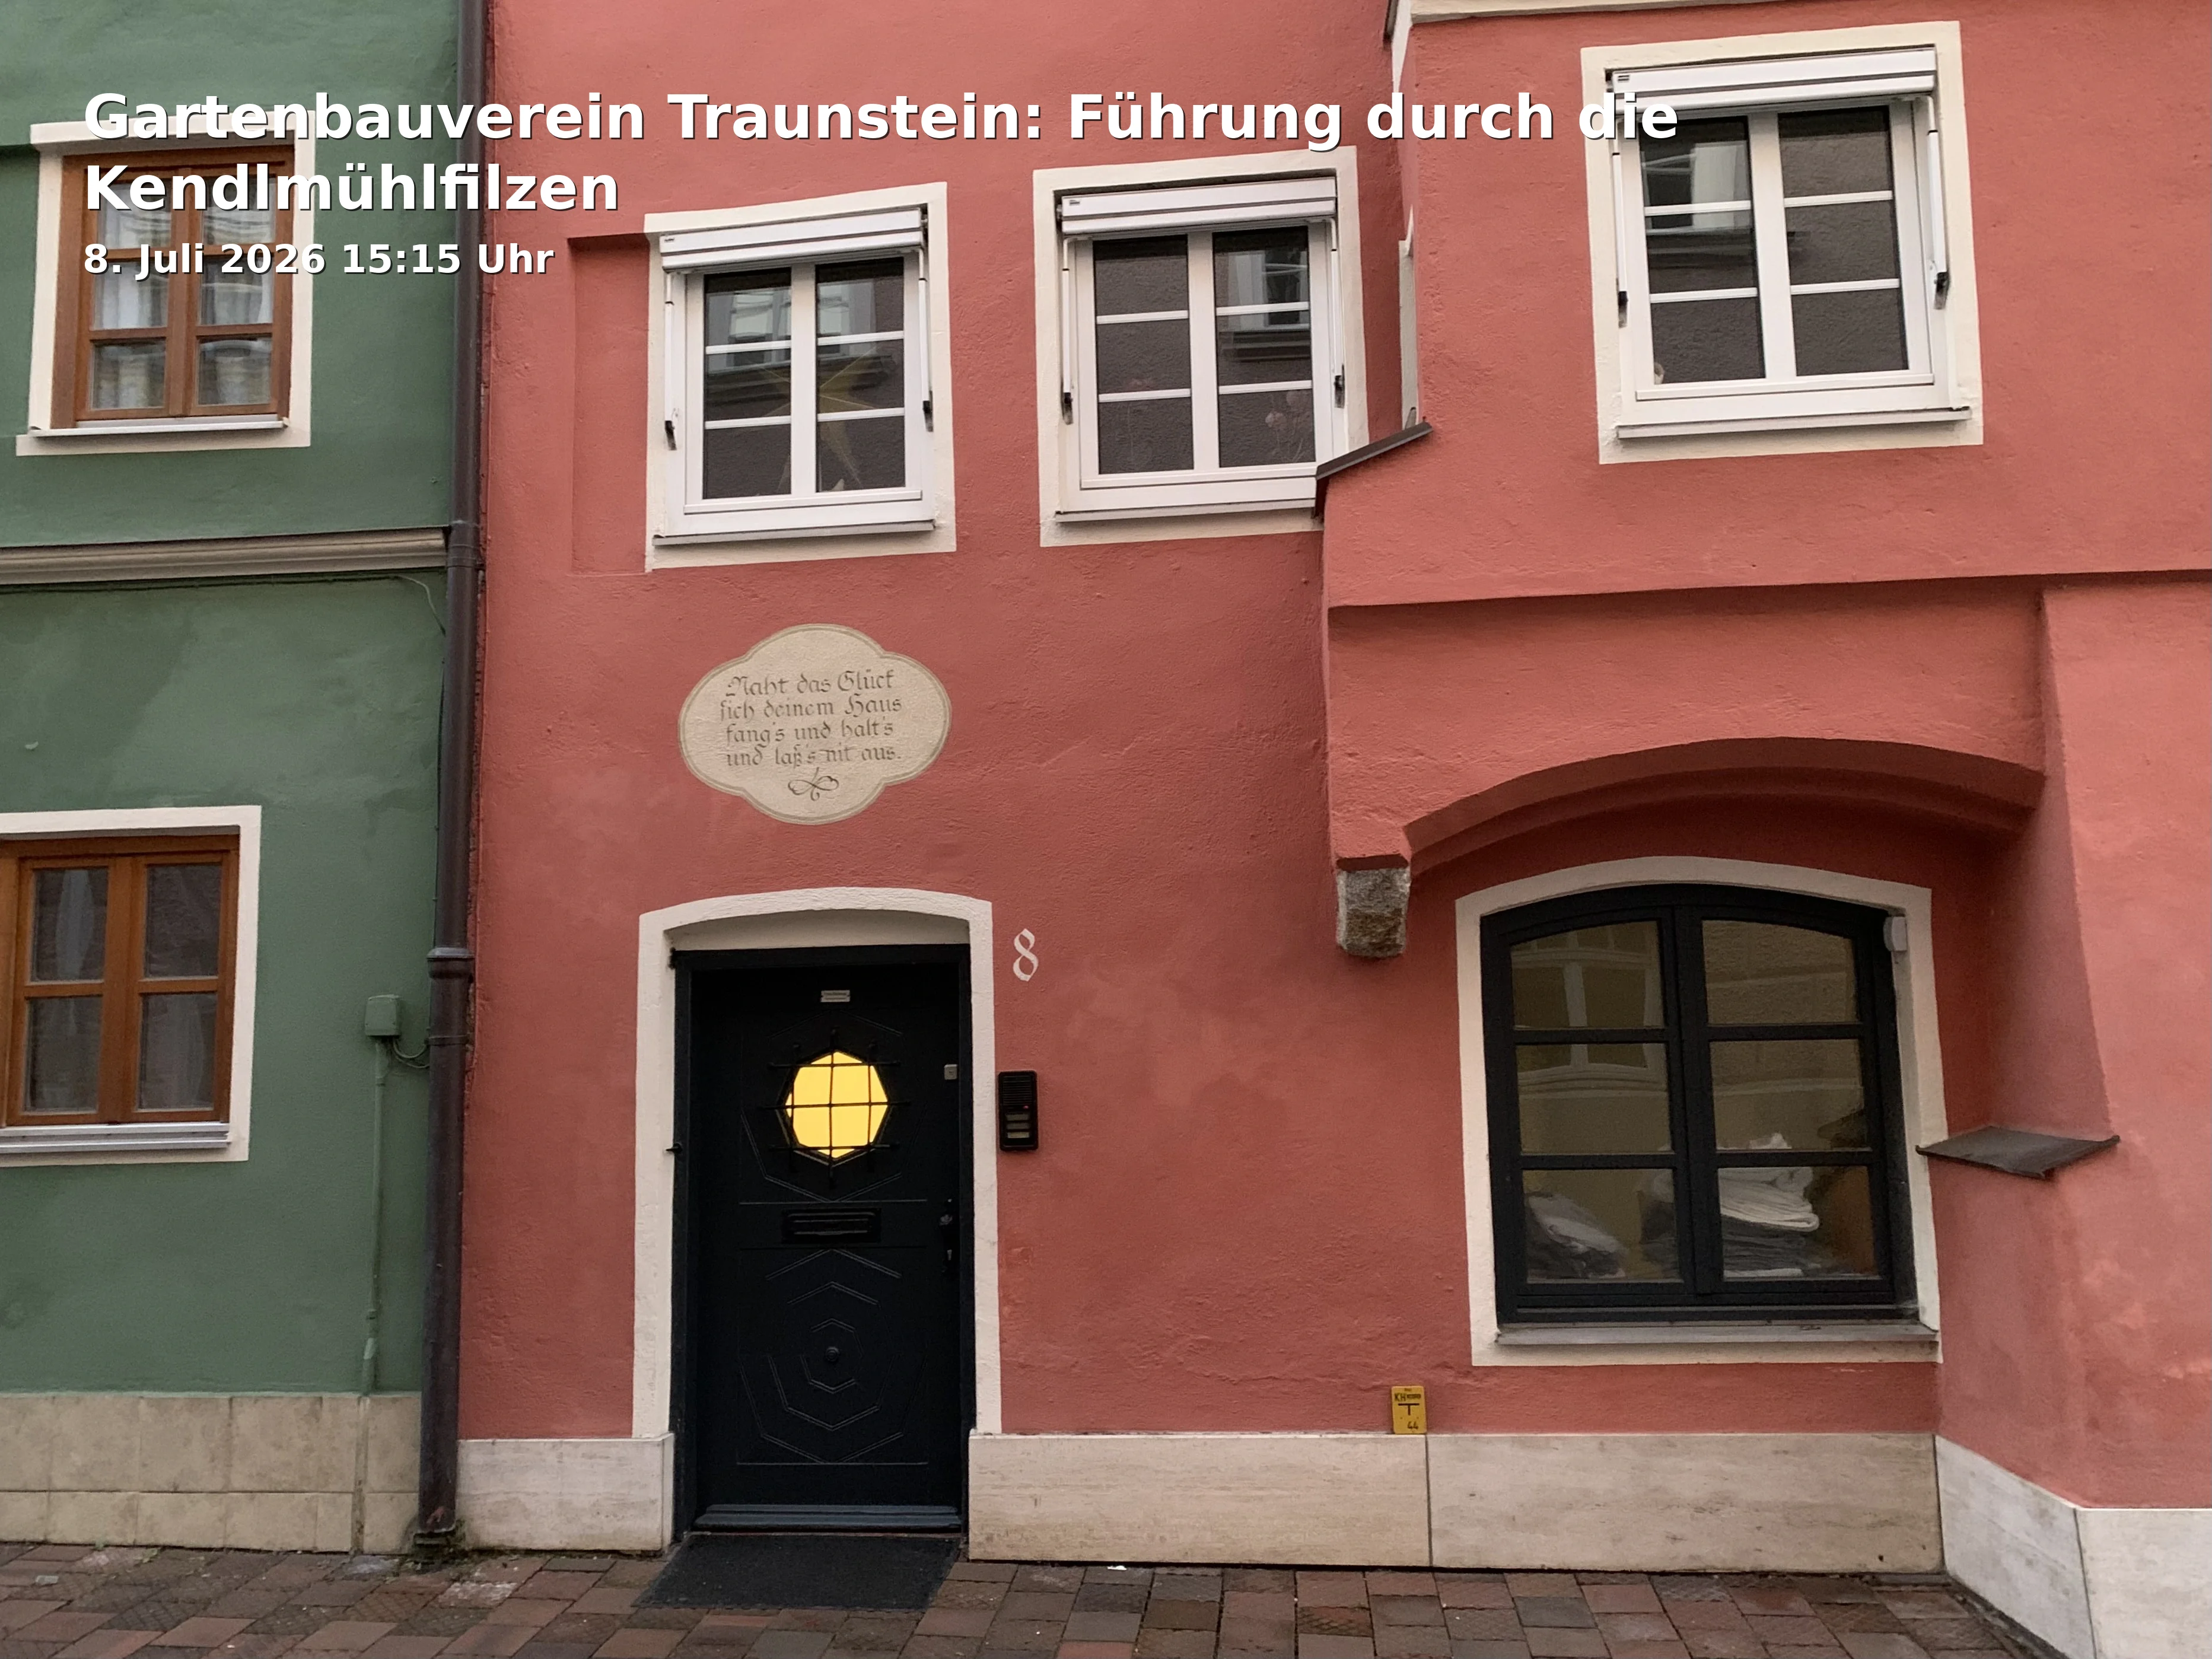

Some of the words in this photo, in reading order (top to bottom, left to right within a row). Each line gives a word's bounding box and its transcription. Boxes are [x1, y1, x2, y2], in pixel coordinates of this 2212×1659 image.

[725, 675, 789, 698] Naht
[797, 673, 831, 693] das
[837, 669, 895, 692] Glück
[763, 697, 835, 718] deinem
[844, 693, 902, 718] Haus
[794, 719, 832, 740] und
[727, 746, 763, 766] und
[1012, 928, 1039, 982] 8
